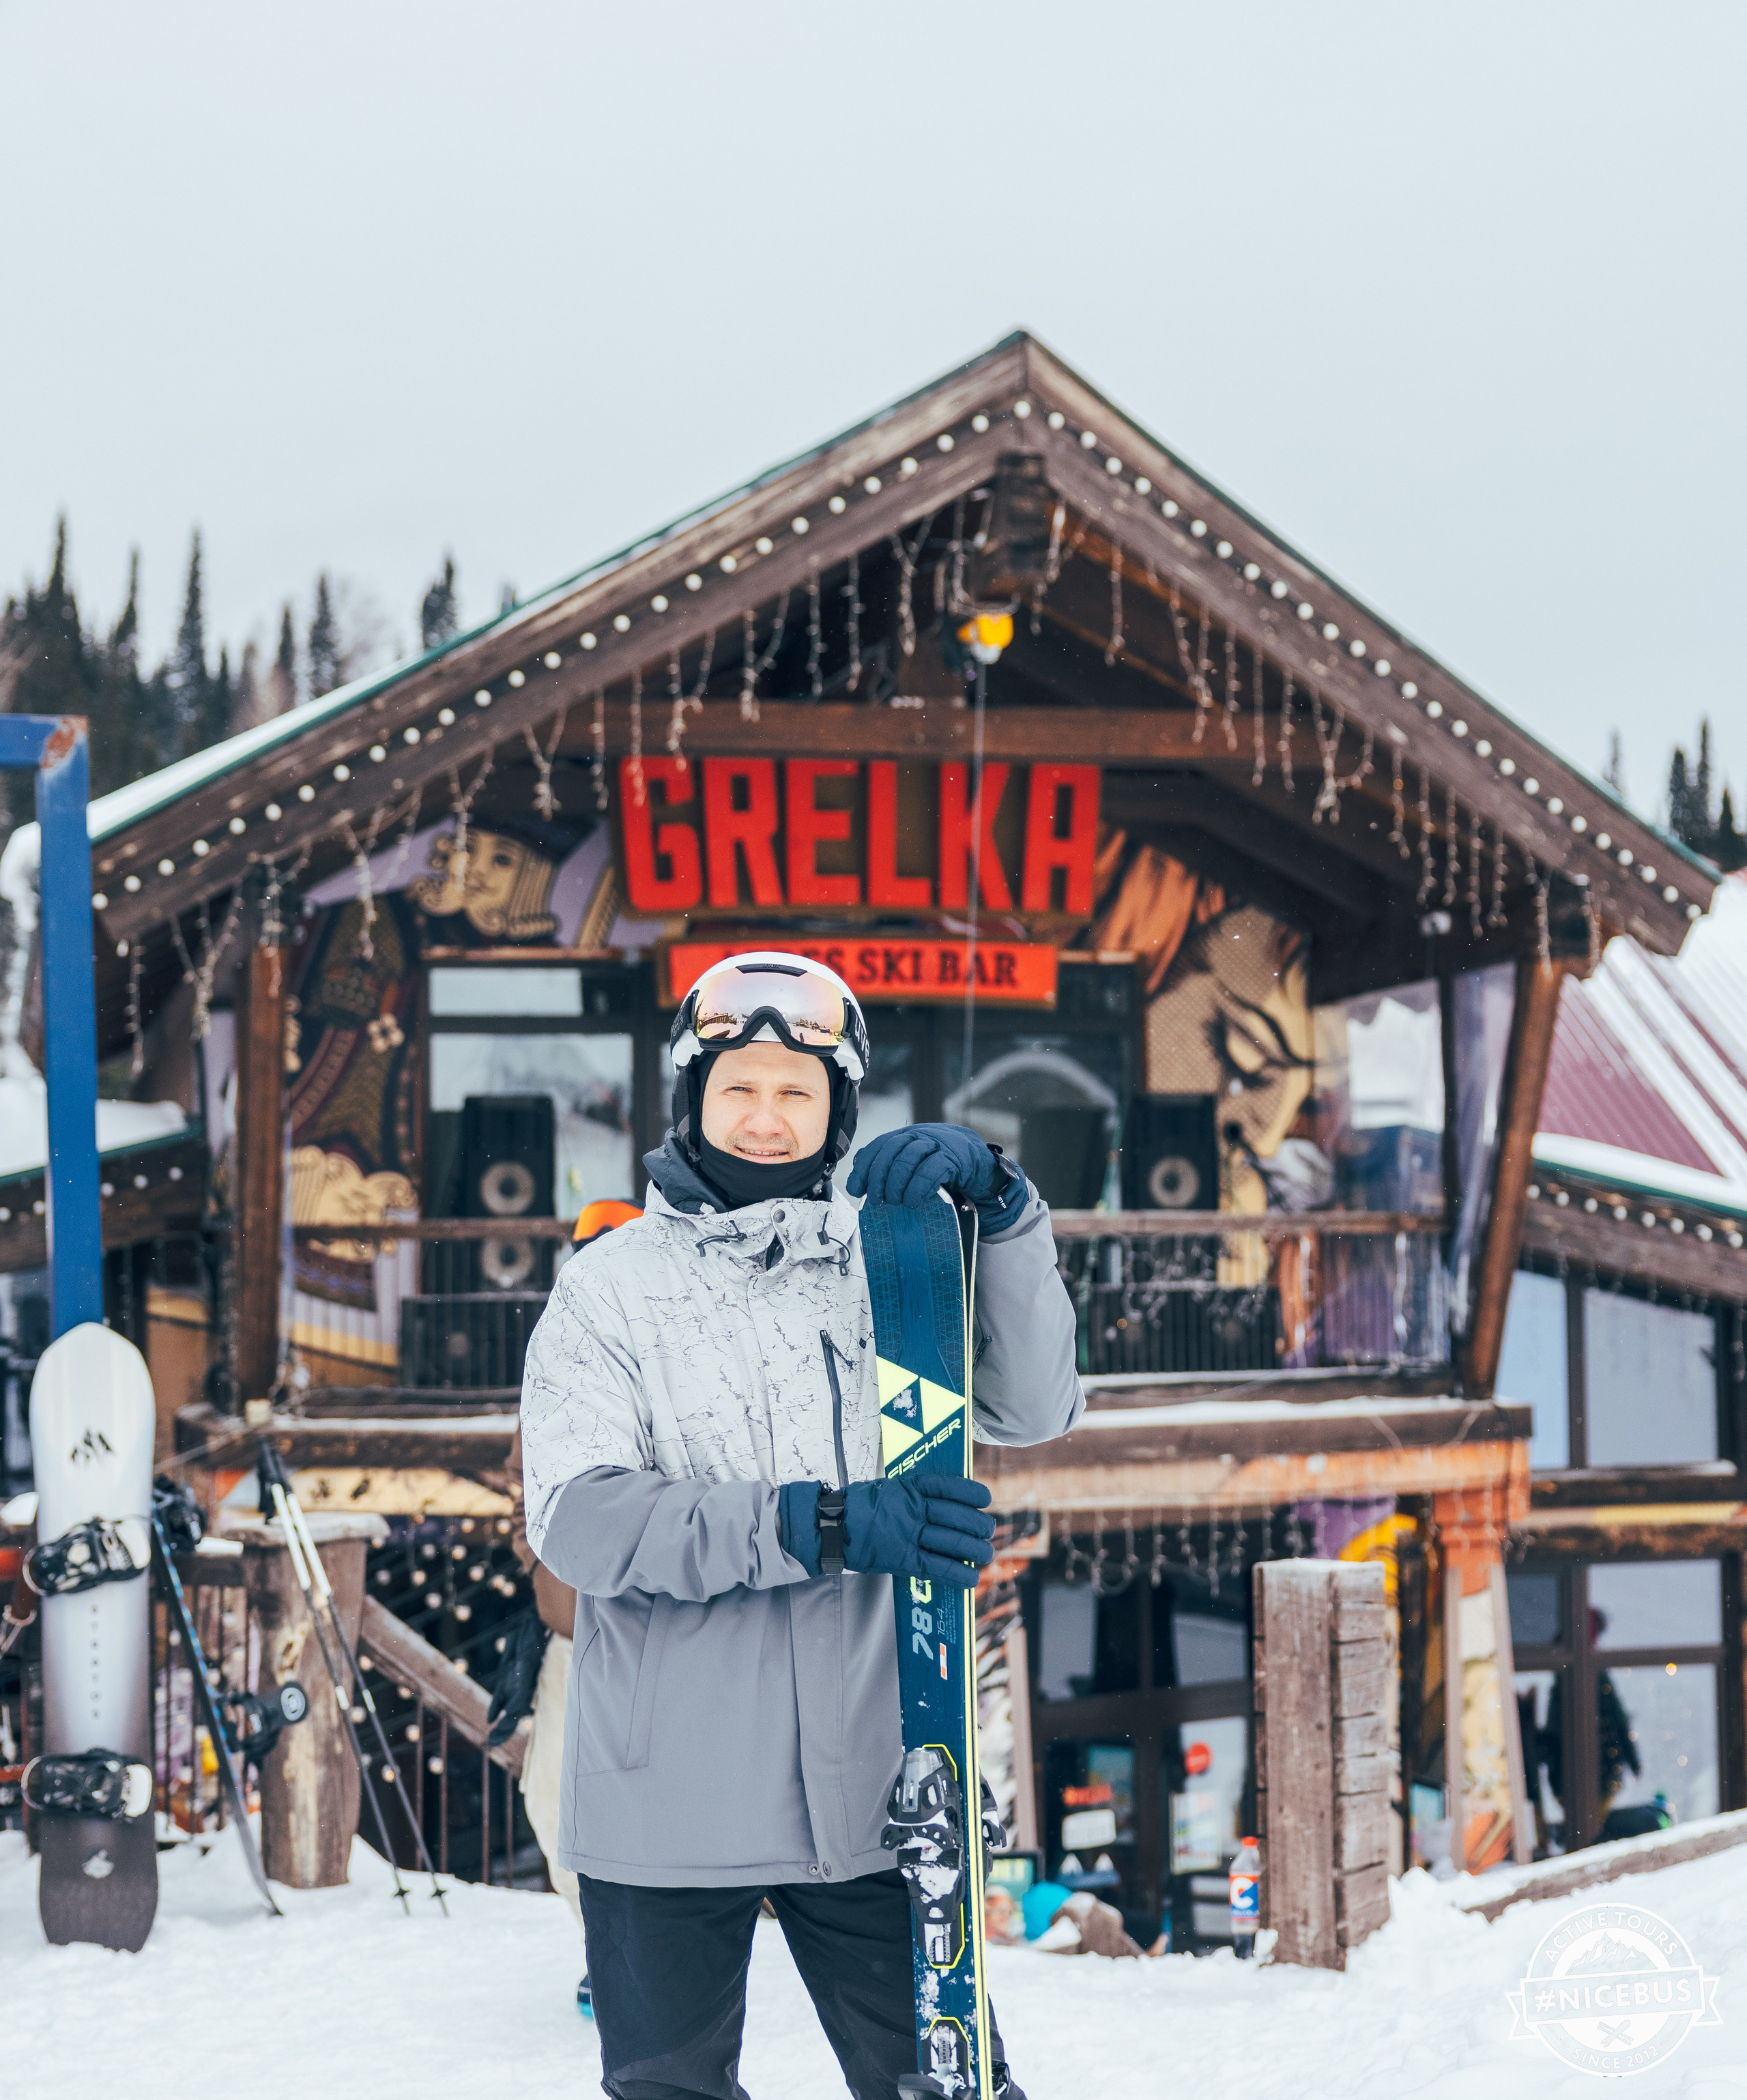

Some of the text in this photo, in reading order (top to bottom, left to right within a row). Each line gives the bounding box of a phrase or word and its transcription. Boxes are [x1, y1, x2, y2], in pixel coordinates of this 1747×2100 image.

[621, 756, 1100, 915] GRELKA
[858, 951, 920, 983] SKI
[940, 951, 1017, 987] BAR
[855, 1015, 870, 1069] uve
[888, 1418, 962, 1479] FISCHER
[912, 1607, 934, 1660] 78
[937, 1607, 945, 1635] 164
